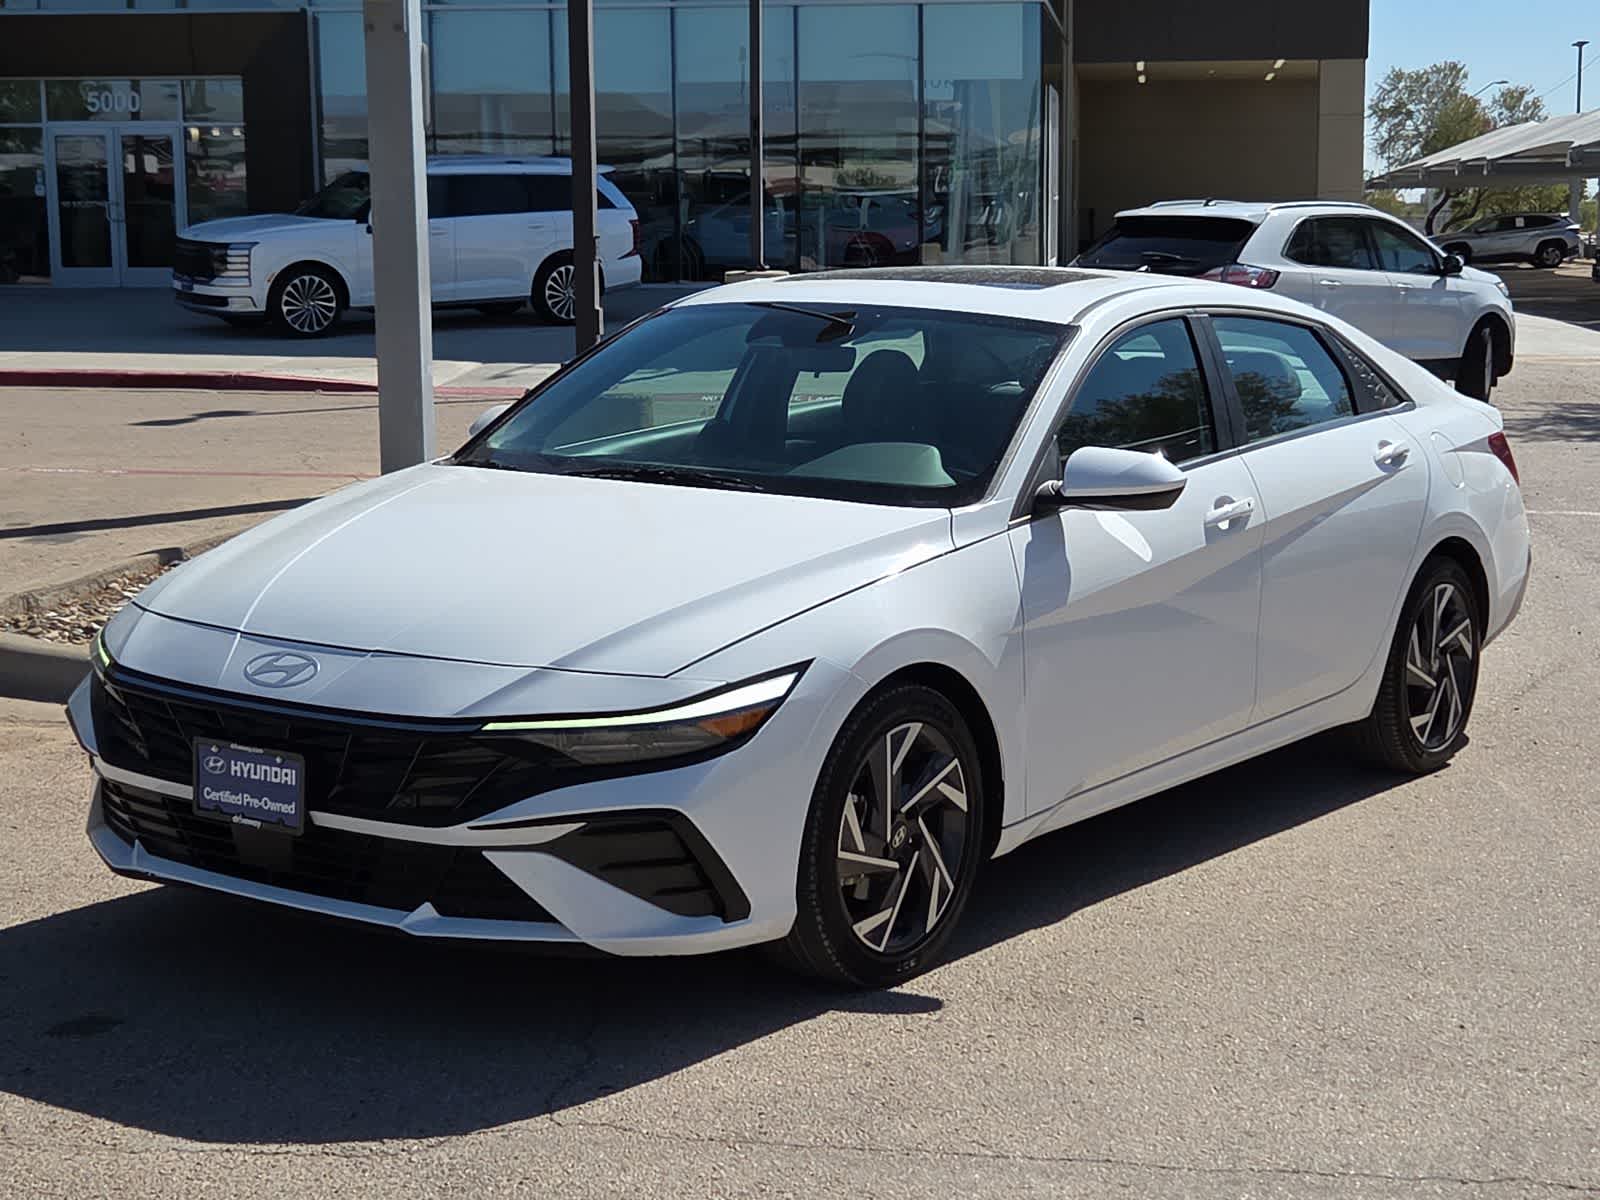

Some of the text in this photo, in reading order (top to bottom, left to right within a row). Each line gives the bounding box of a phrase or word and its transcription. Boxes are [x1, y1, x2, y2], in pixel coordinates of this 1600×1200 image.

[87, 91, 141, 112] 5000
[230, 760, 296, 786] HYUNDAI
[203, 787, 296, 814] Certified Pre-Owned
